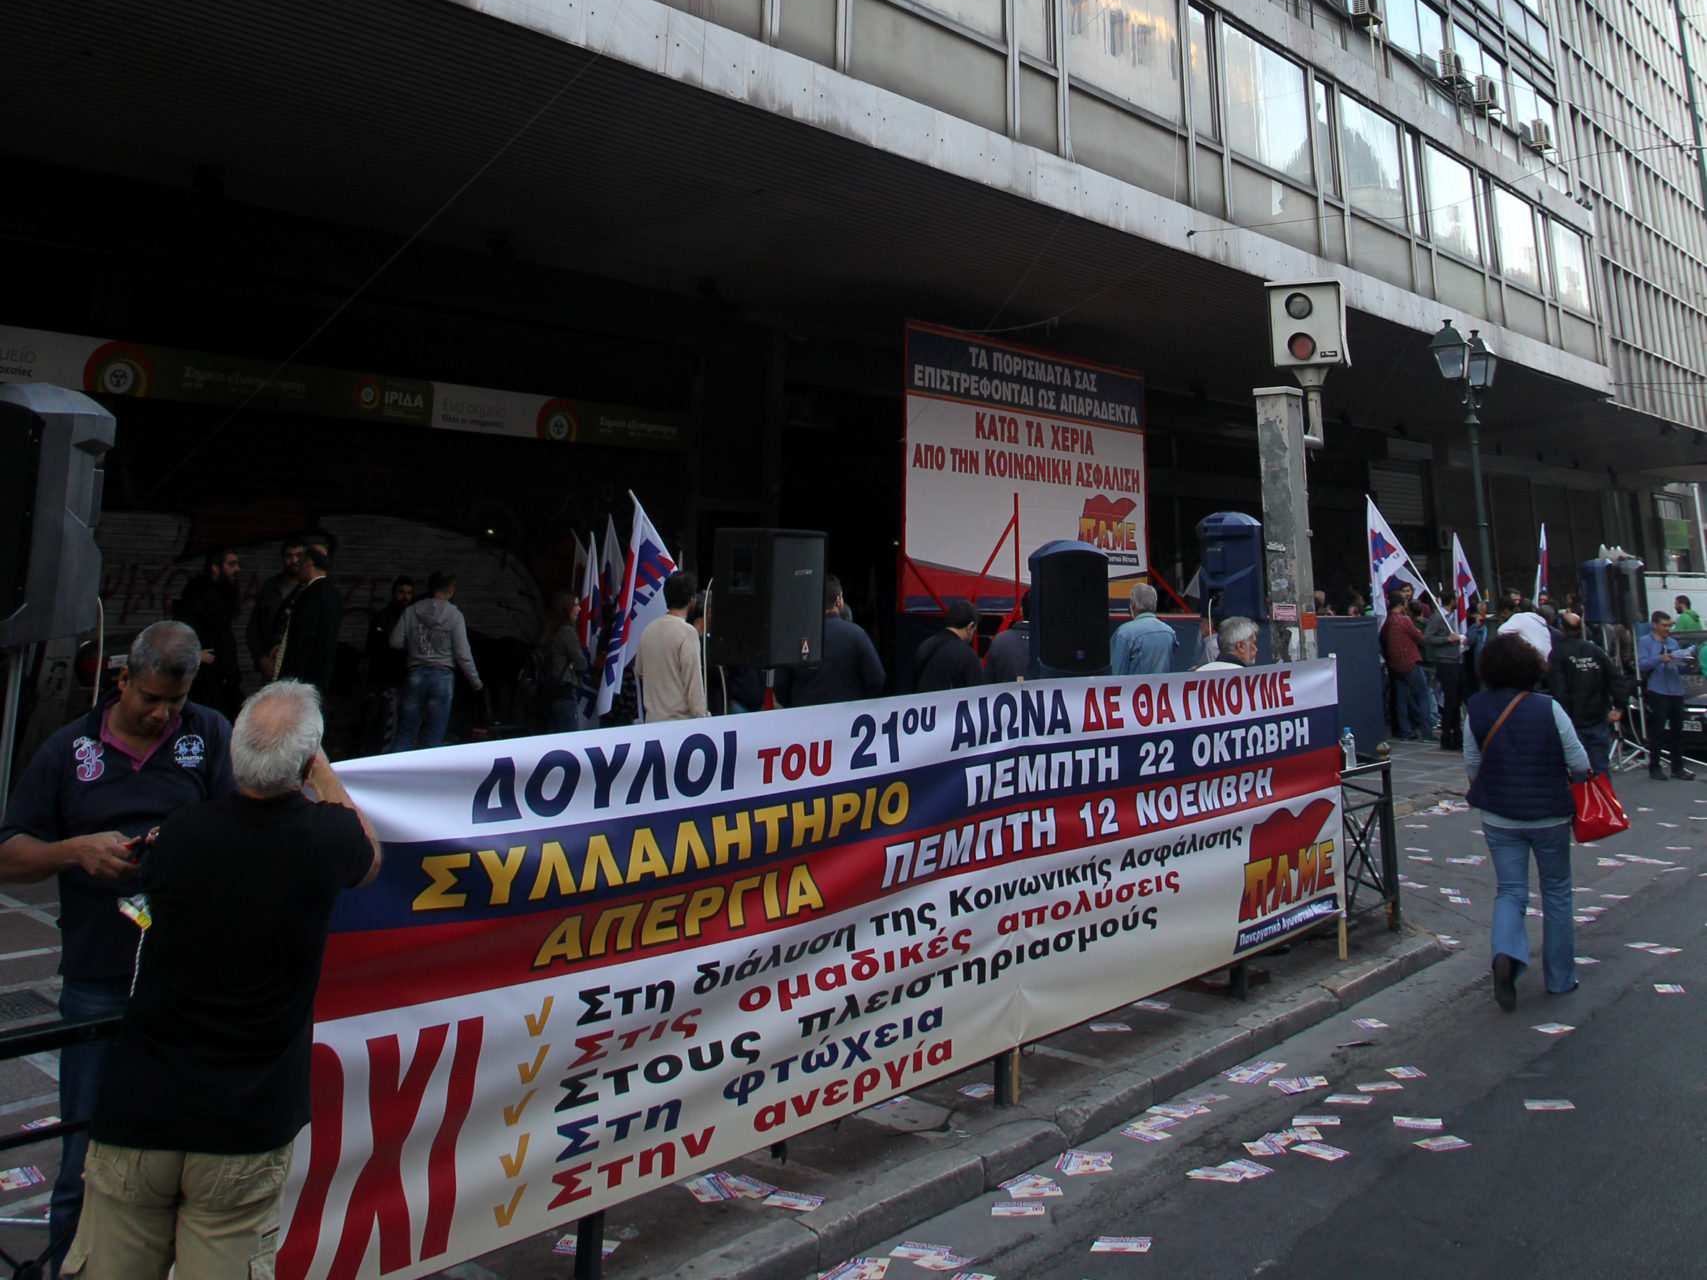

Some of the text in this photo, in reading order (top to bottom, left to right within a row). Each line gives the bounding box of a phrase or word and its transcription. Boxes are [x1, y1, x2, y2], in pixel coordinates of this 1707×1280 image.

[384, 391, 425, 409] ΙΡΙΔΑ
[914, 364, 1138, 425] ΕΠΙΣΤΡΕΦΟΝΤΑΙ ΩΣ ΑΠΑΡΑΔΕΚΤΑ
[969, 346, 1098, 393] ΤΑ ΠΟΡΙΣΜΑΤΑ ΣΑΣ
[912, 443, 1140, 494] ΑΠΟ ΤΗΝ ΚΟΙΝΩΝΙΚΗ ΑΣΦΑΛΙΣΗ
[975, 411, 1095, 456] ΚΑΤΩ ΤΑ ΧΕΡΙΑ
[471, 730, 738, 825] ΔΟΥΛΟΙ
[850, 704, 937, 771] 21ου
[950, 687, 1072, 752] ΑΙΩΝΑ
[1081, 685, 1125, 733] ΔΕ
[1131, 679, 1177, 728] ΘΑ
[1182, 669, 1296, 722] ΓΙΝΟΥΜΕ
[964, 716, 1311, 808] ΠΕΜΠΤΗ 22 ΟΚΤΩΒΡΗ
[411, 780, 910, 913] ΣΥΛΛΑΛΗΤΗΡΙΟ
[880, 767, 1274, 892] ΠΕΜΠΤΗ 12 ΝΟΕΜΒΡΗ
[530, 863, 826, 971] ΑΠΕΡΓΙΑ
[567, 867, 1181, 1070] Στις ομαδικές απολύσεις
[576, 825, 1244, 1027] Στη διάλυση της Κοινωνικής Ασφάλισης
[554, 902, 1160, 1113] Στους πλειστηριασμούς
[546, 1035, 954, 1211] Στην ανεργία
[555, 1003, 945, 1163] Στη φτώχεια
